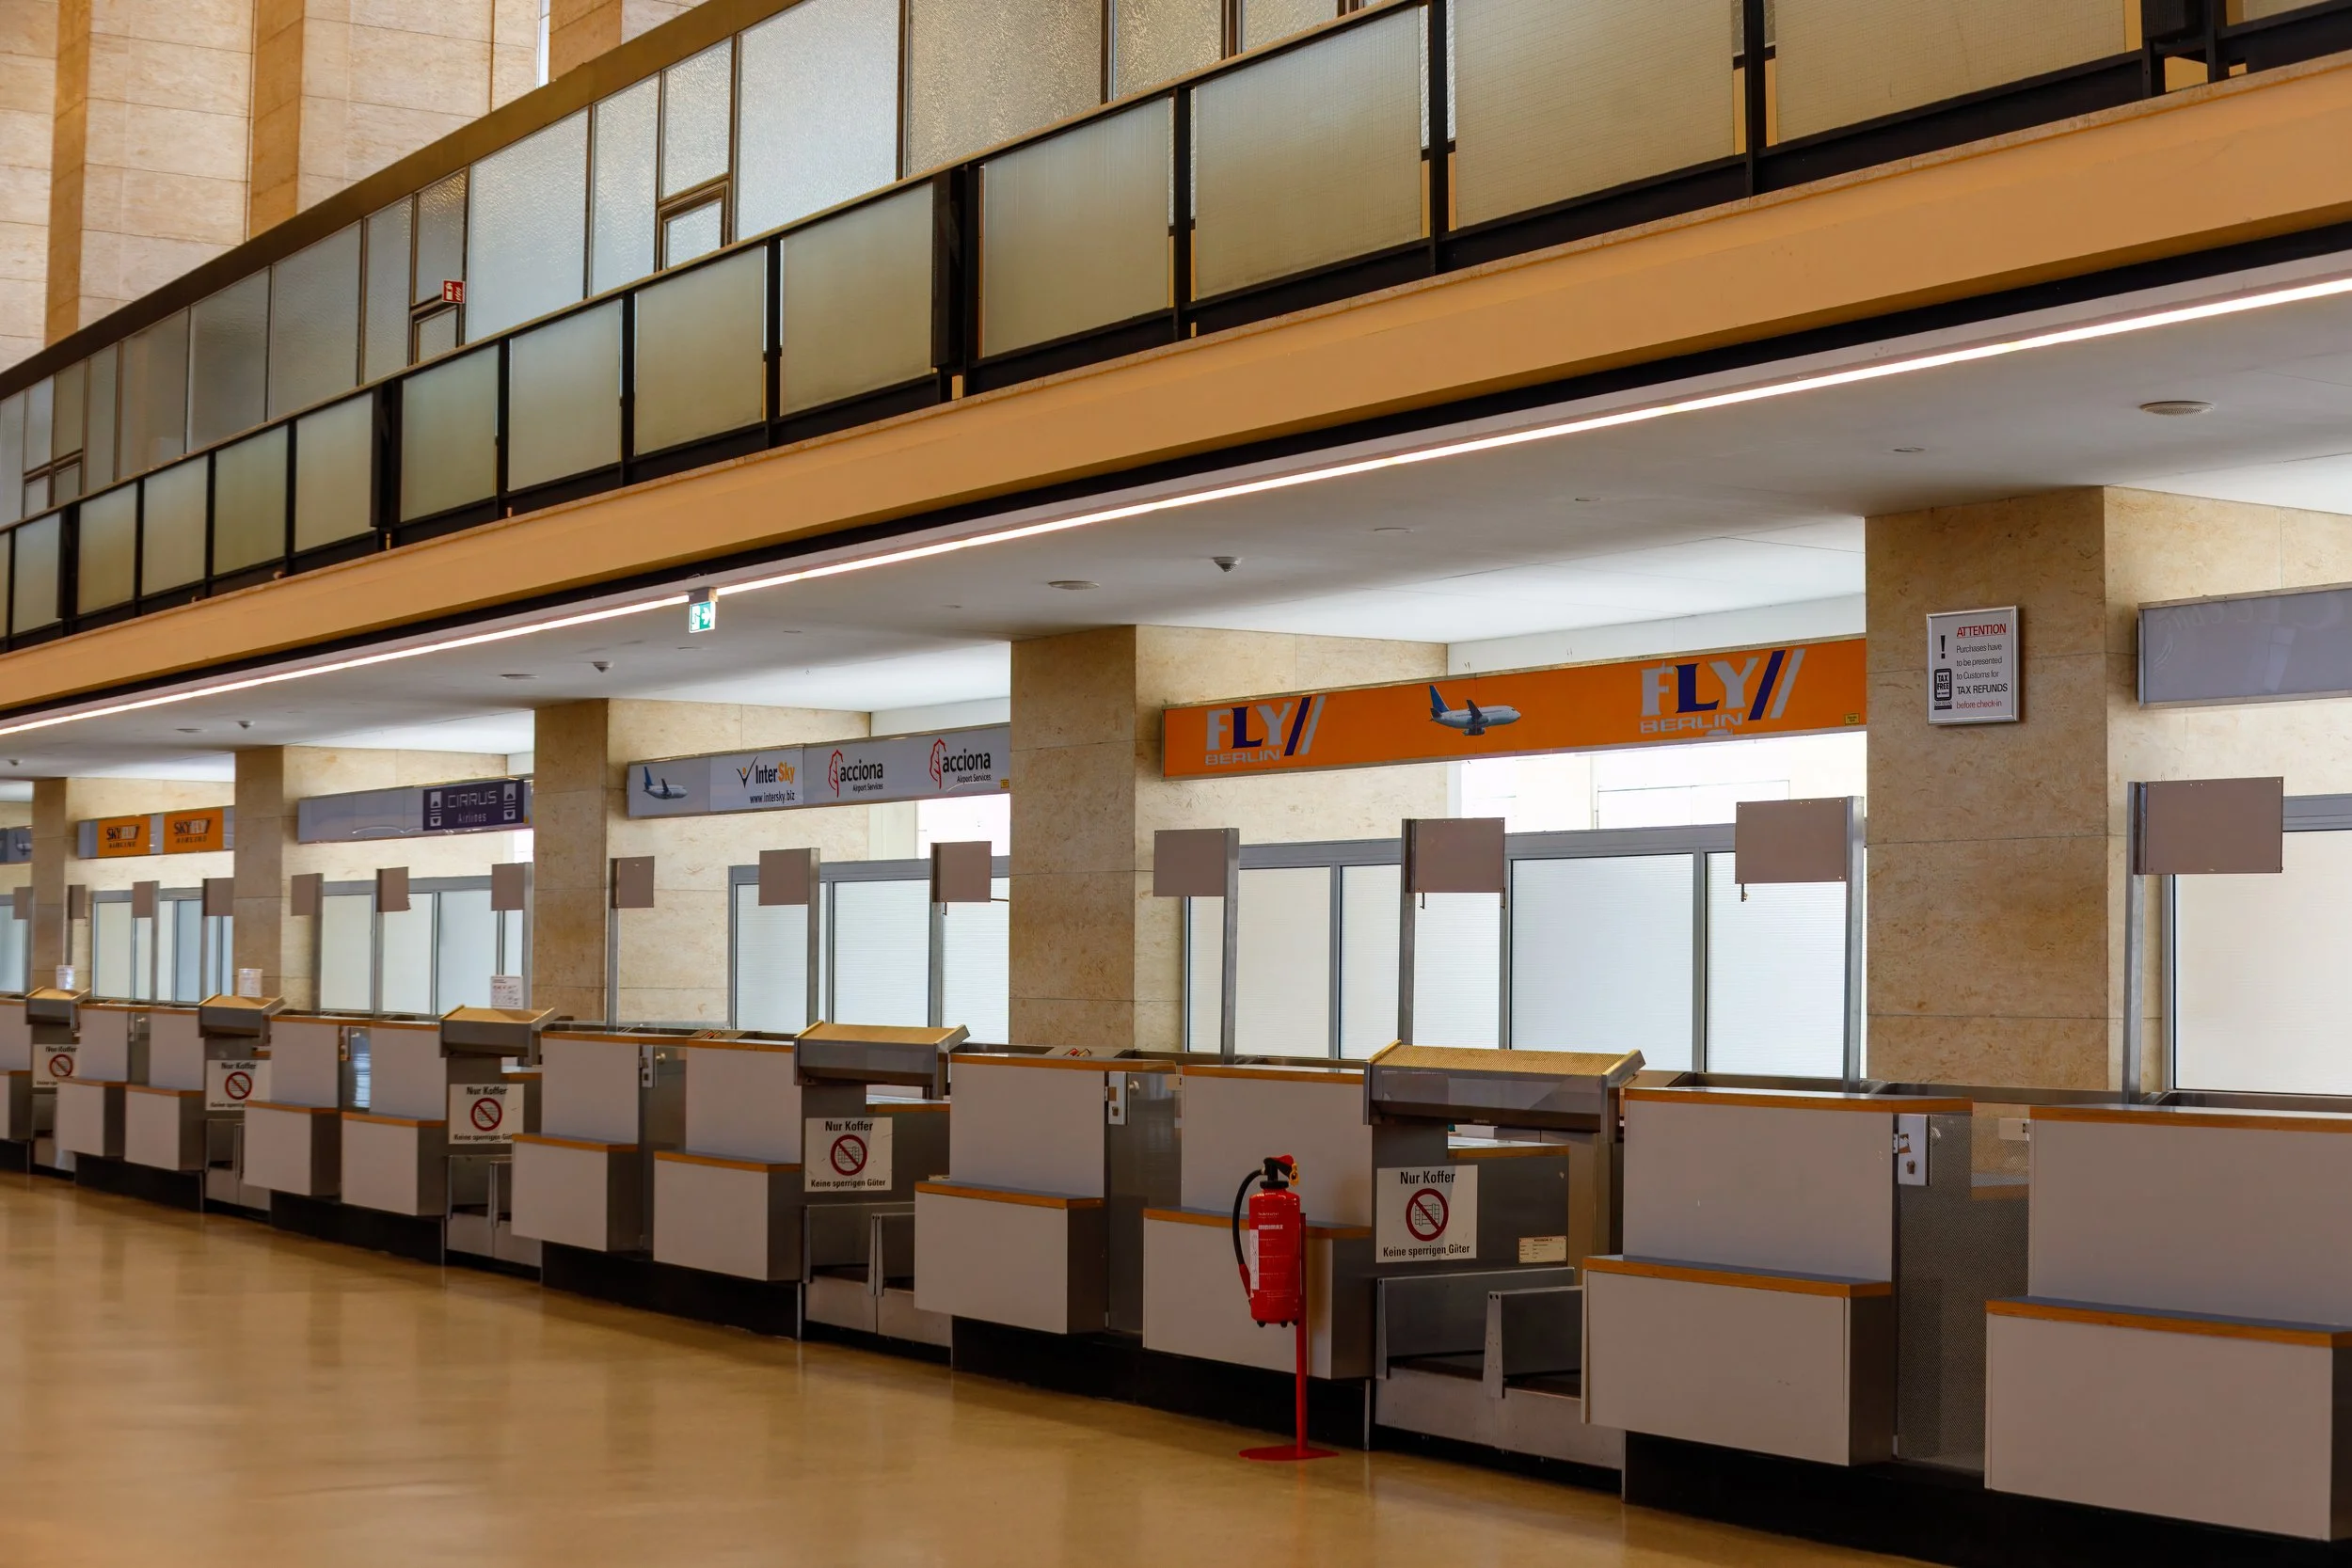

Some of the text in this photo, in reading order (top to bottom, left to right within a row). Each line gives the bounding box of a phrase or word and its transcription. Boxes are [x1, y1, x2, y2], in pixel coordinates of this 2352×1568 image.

[1957, 624, 2007, 638] ATTENTION
[1957, 644, 1987, 653] Purchases
[1972, 657, 2002, 669] presented
[1963, 671, 1990, 679] Customs
[1991, 670, 1999, 678] for
[1957, 683, 2008, 694] TAX REFUNDS
[1957, 701, 1975, 709] before
[1977, 699, 2002, 708] check-in
[1640, 712, 1742, 734] BERLIN
[943, 749, 991, 773] acciona
[1204, 749, 1280, 766] BERLIN
[755, 762, 796, 784] InterSky
[839, 759, 883, 782] acciona
[957, 773, 991, 784] Airport Services
[852, 782, 883, 793] Airport Services
[448, 790, 497, 808] CIRRUS
[750, 790, 795, 805] www.intersky.biz
[457, 813, 487, 824] Airlines
[467, 1085, 508, 1095] Nur Koffer
[825, 1121, 873, 1131] Nur Koffer
[1400, 1170, 1455, 1184] Nur Koffer
[833, 1179, 866, 1189] sperrigen
[867, 1178, 886, 1186] Güter
[1383, 1243, 1470, 1259] Keine sperrigen Güter
